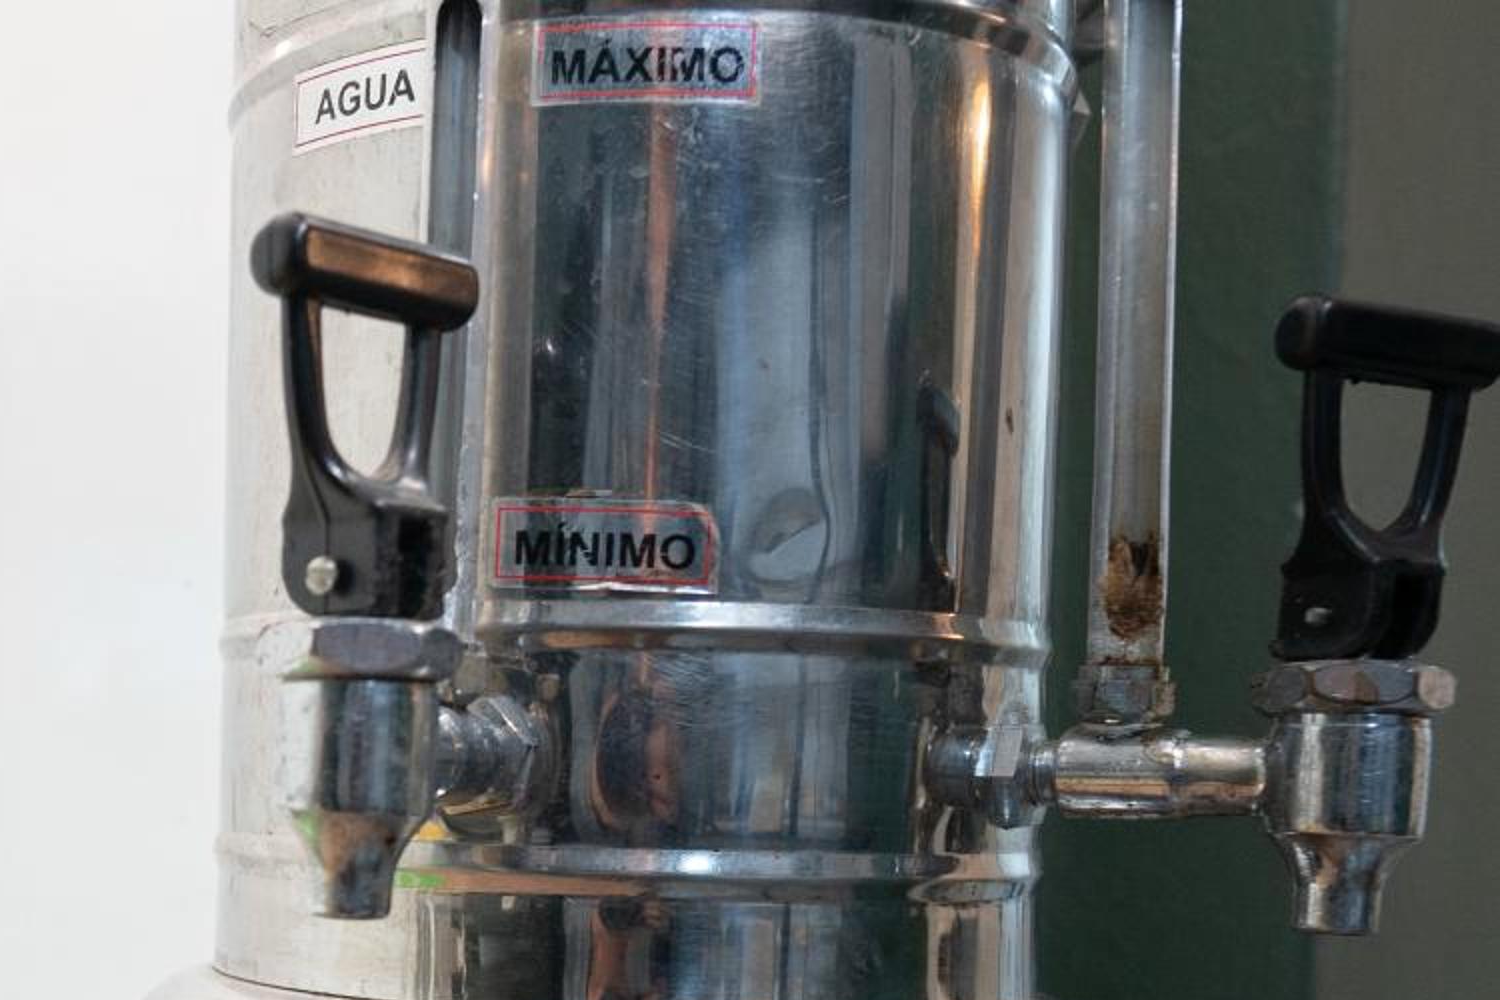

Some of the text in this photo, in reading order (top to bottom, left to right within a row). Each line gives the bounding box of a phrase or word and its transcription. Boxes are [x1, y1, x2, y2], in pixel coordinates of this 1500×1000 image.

[550, 39, 745, 86] MÁXIMO
[315, 68, 415, 125] AGUA
[515, 522, 696, 569] MÍNIMO
